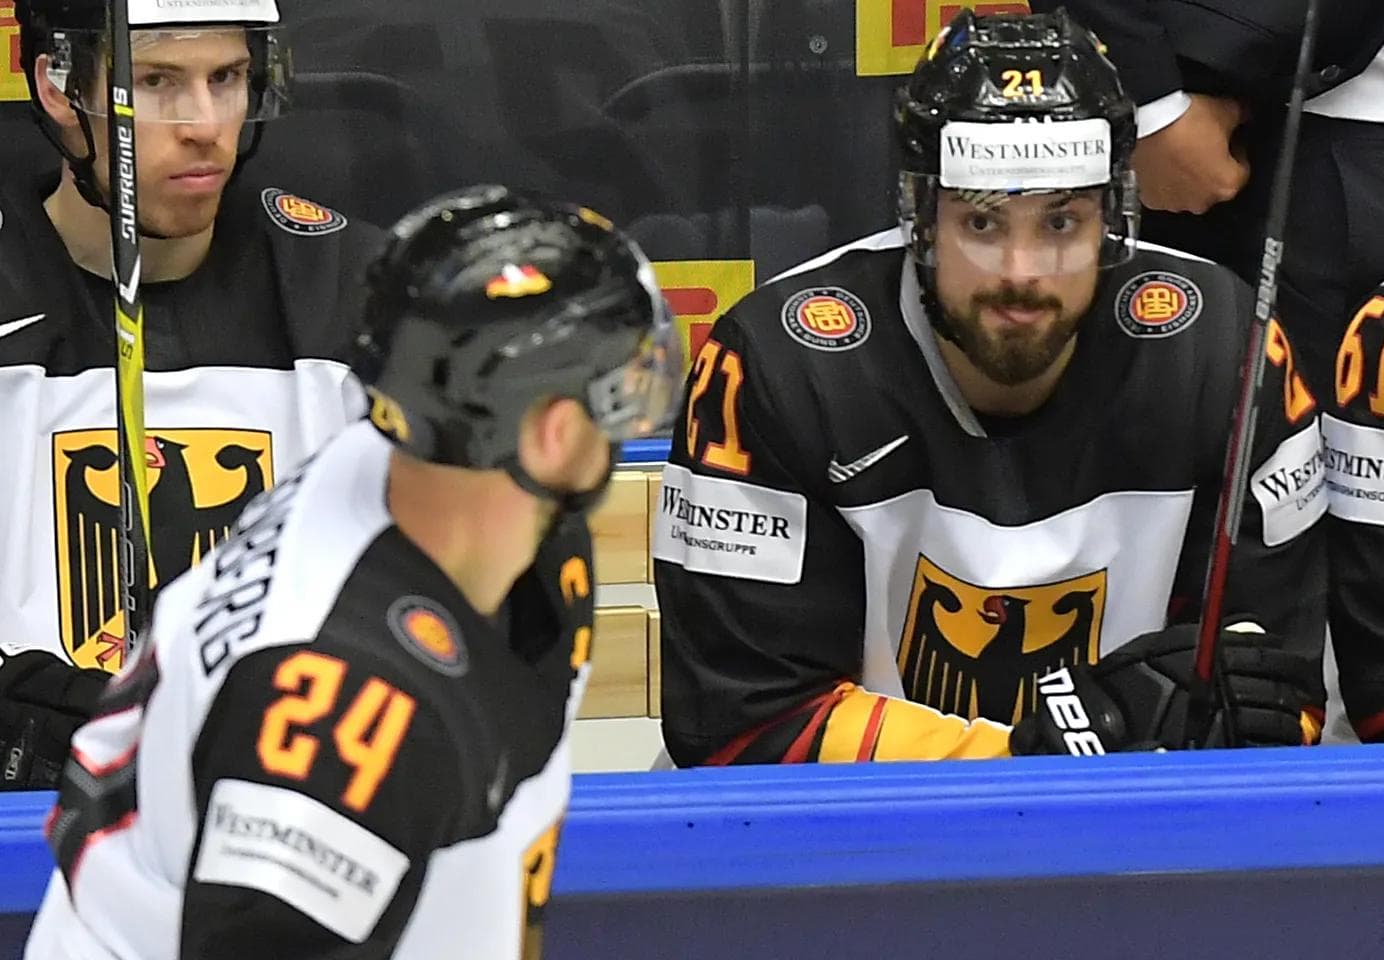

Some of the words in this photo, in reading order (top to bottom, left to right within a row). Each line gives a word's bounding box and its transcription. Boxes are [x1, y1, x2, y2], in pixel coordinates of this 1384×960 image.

[1001, 70, 1044, 97] 21
[946, 136, 1105, 160] WESTMINSTER
[686, 339, 750, 474] 21
[256, 650, 416, 812] 24
